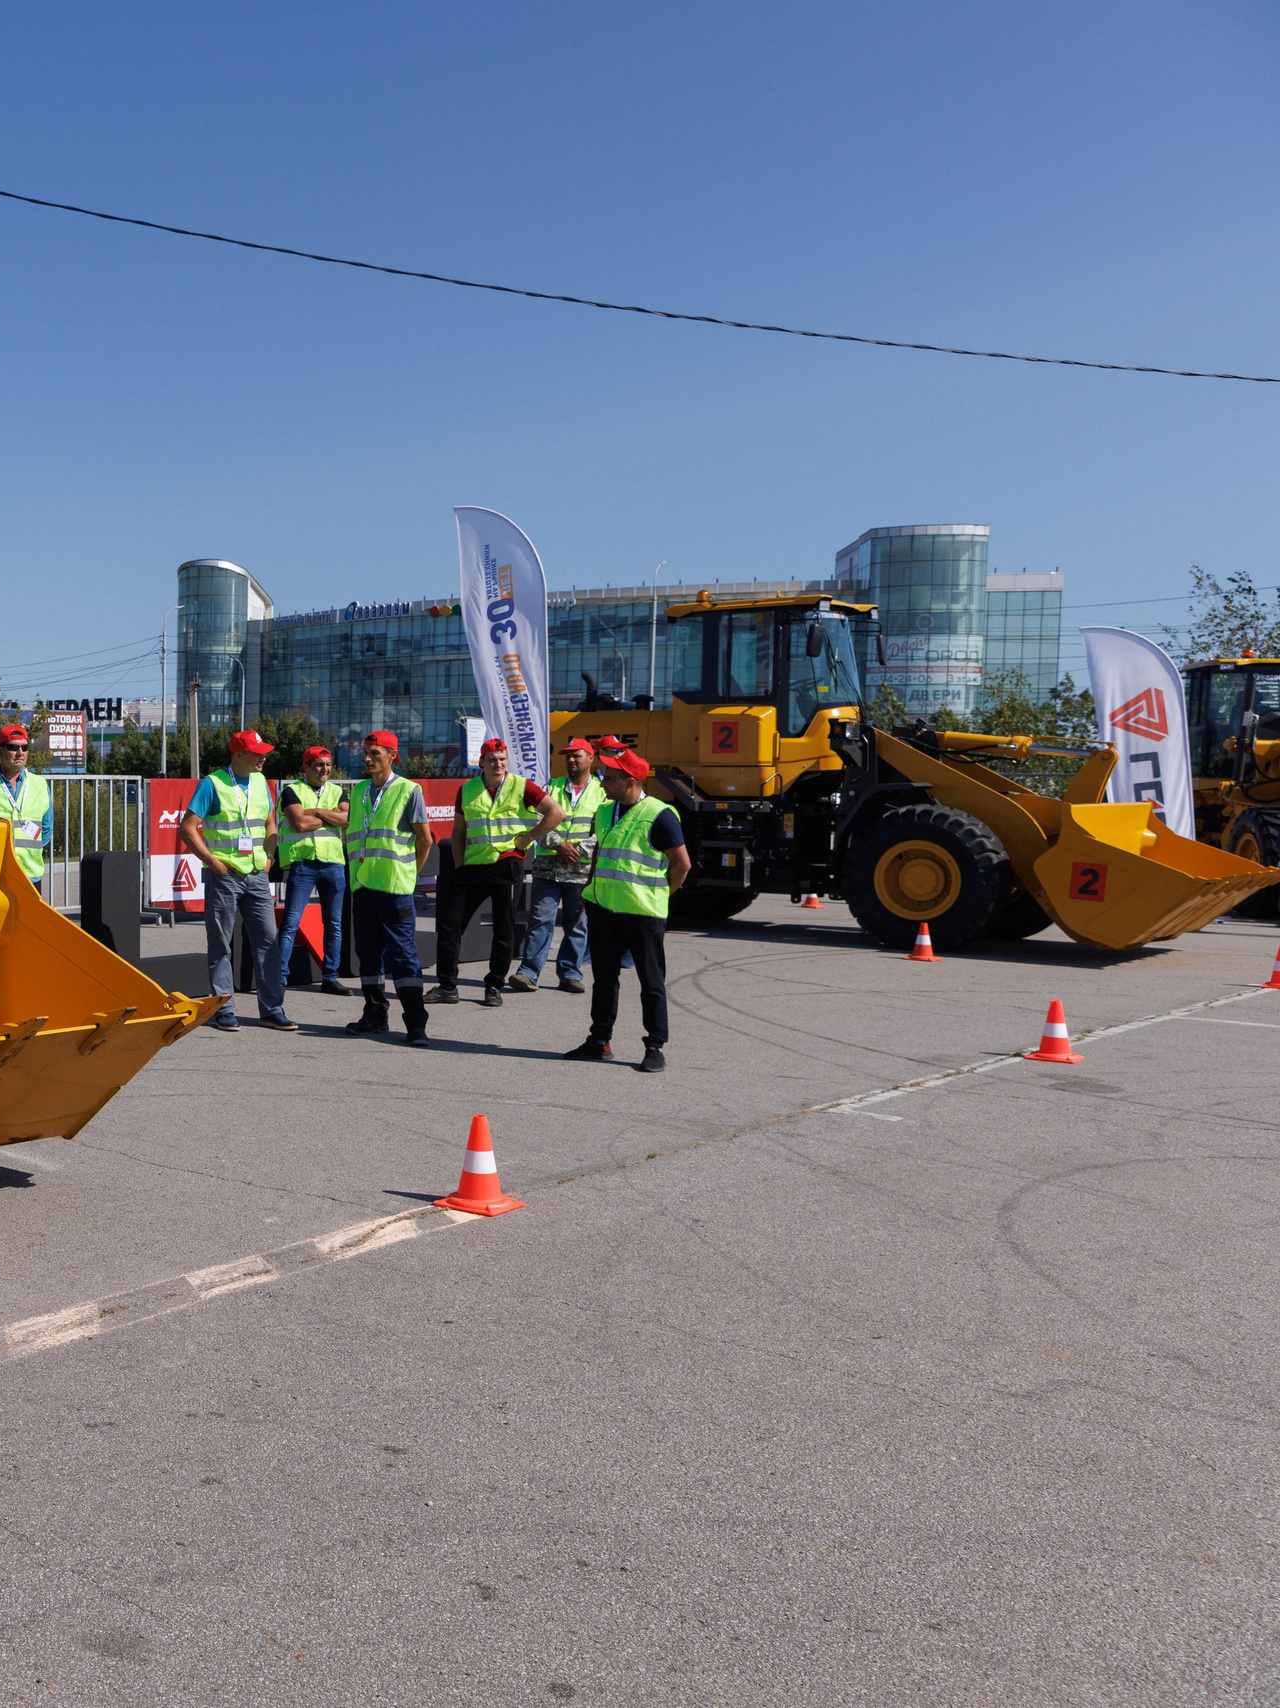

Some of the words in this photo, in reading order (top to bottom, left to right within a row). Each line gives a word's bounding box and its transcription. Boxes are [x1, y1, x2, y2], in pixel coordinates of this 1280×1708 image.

[49, 724, 83, 733] ОХРАНА
[718, 725, 733, 749] 2
[1078, 868, 1100, 896] 2
